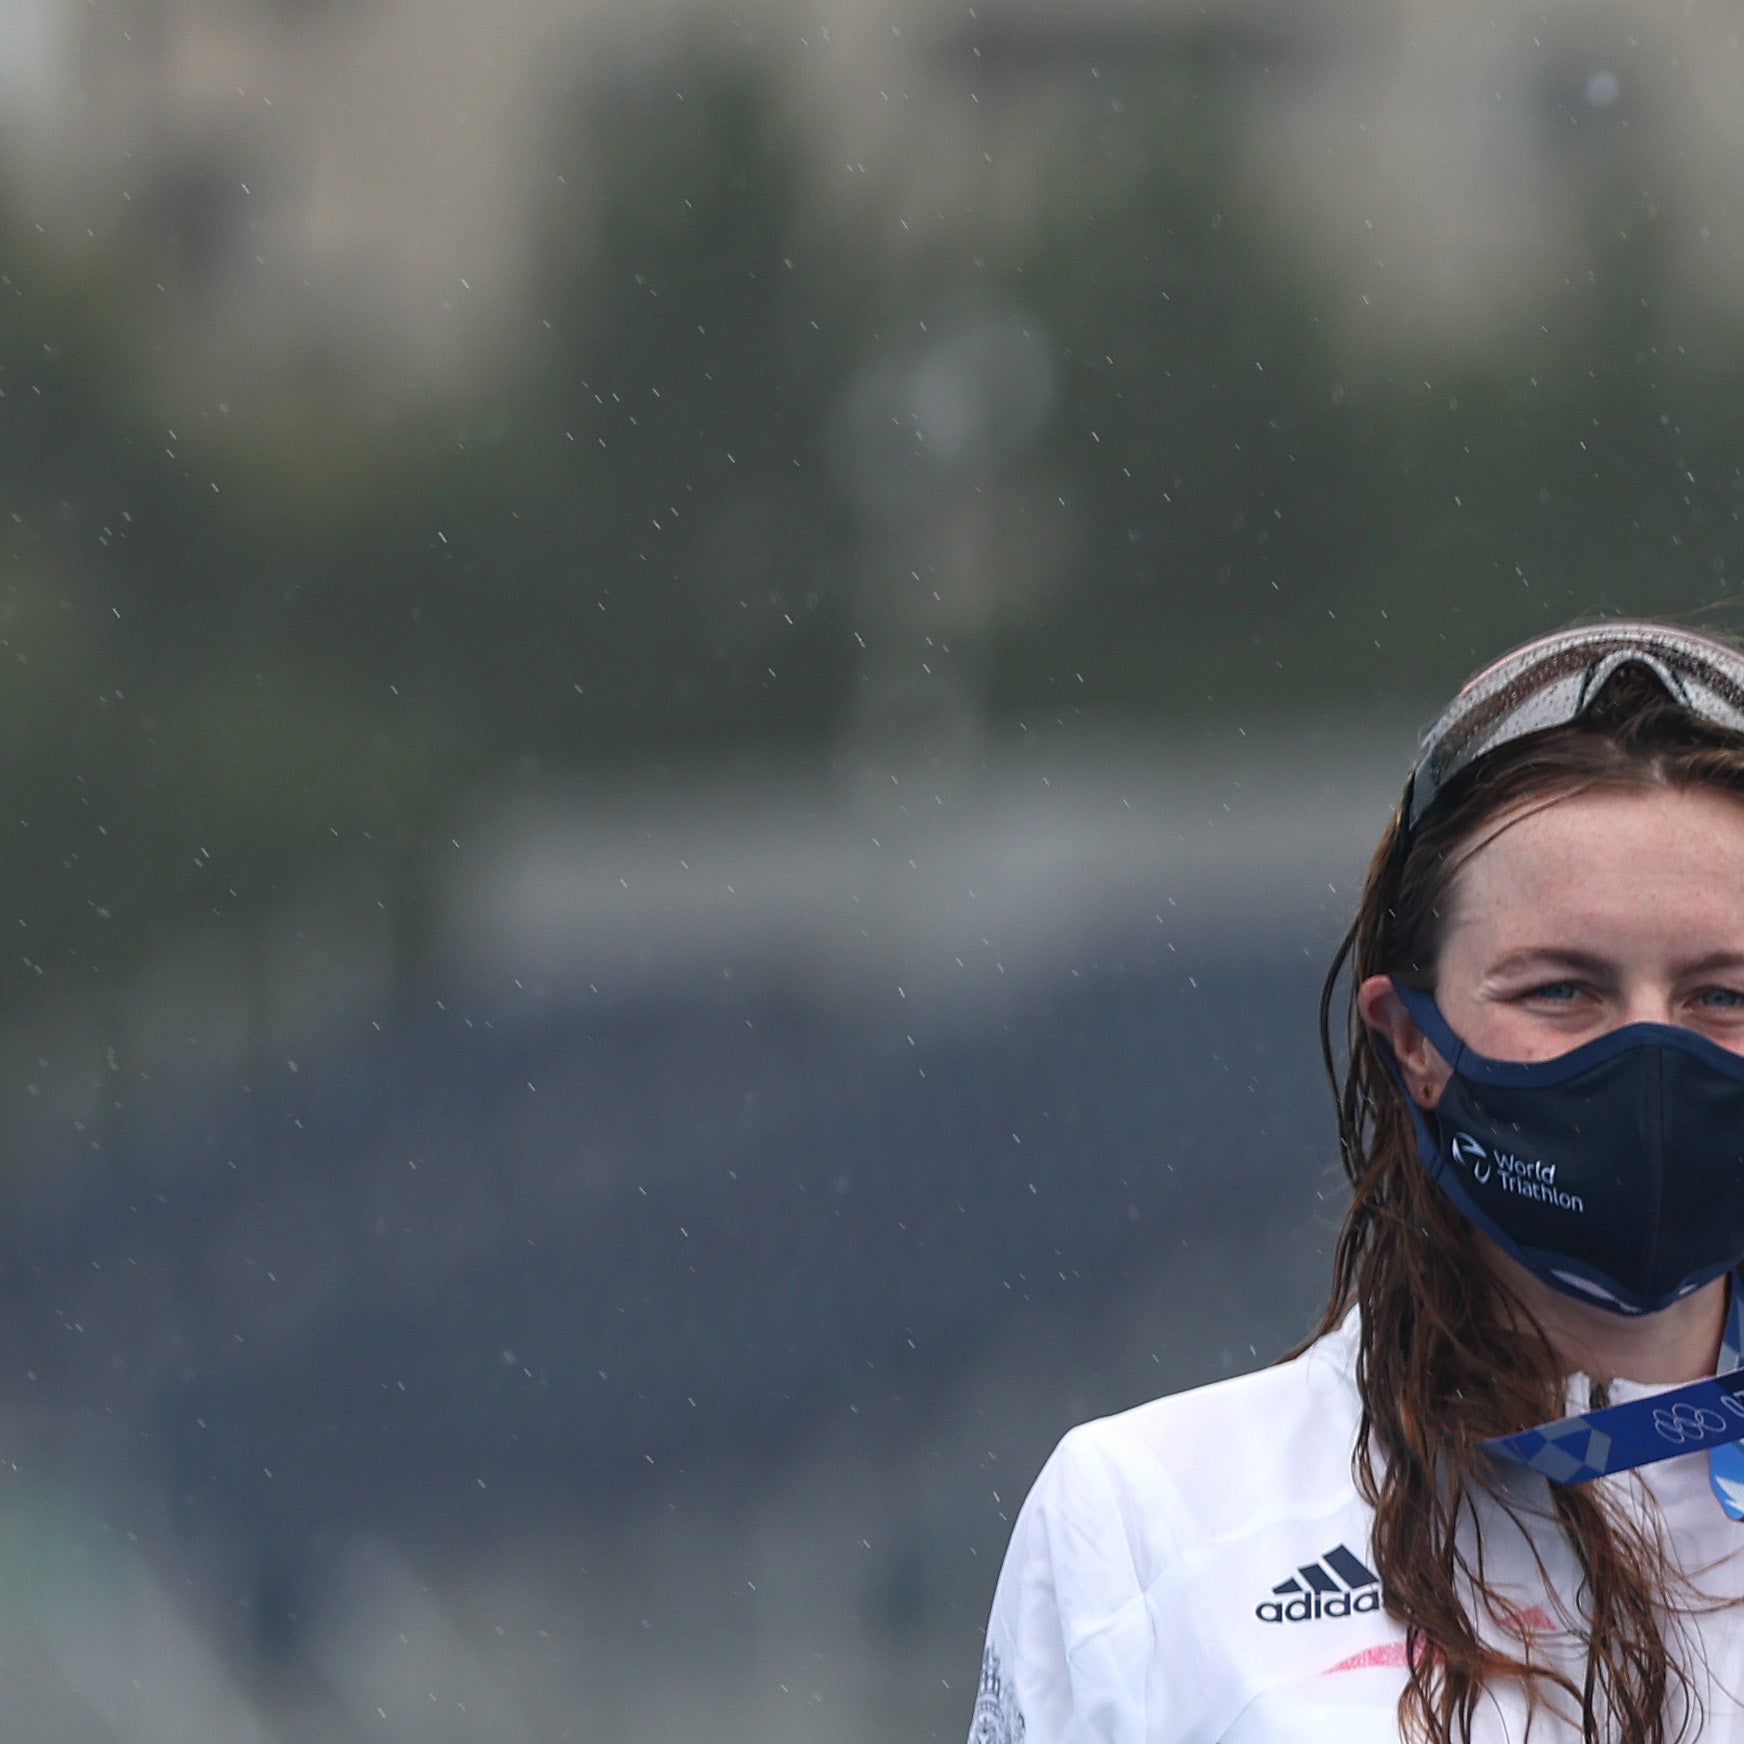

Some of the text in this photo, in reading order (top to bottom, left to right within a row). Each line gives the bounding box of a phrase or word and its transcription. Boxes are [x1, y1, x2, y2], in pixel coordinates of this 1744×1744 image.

[1494, 1150, 1555, 1185] World
[1497, 1170, 1583, 1213] Triathlon
[1255, 1589, 1380, 1623] adida
